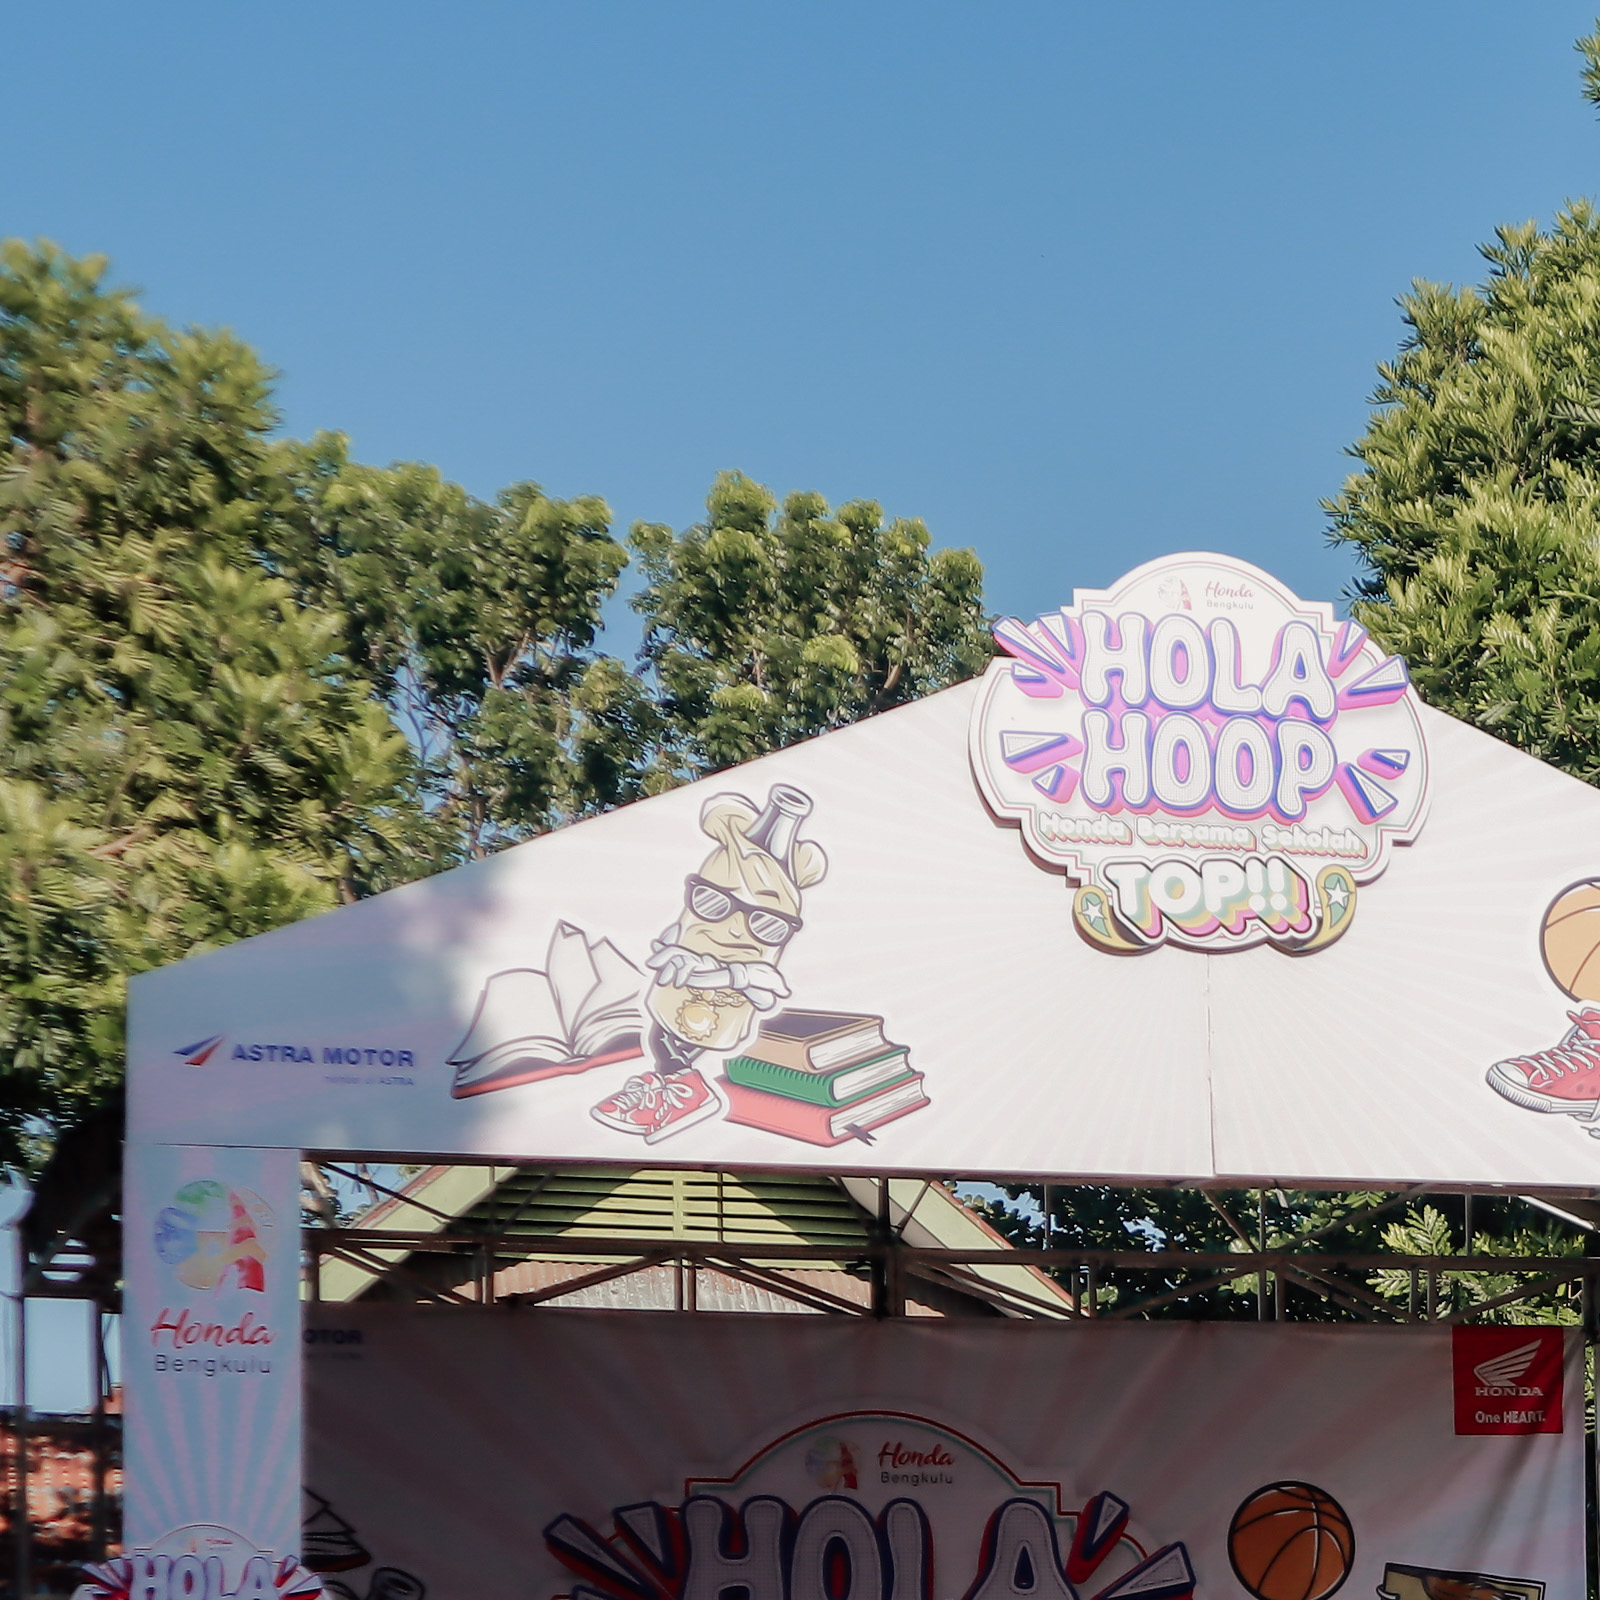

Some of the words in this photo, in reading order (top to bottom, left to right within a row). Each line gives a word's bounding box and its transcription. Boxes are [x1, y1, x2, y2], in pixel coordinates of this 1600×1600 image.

[1205, 580, 1254, 599] Honda
[1206, 600, 1254, 610] Bengkulu
[1081, 612, 1336, 720] HOLA
[1080, 708, 1337, 816] HOOP
[1040, 813, 1131, 844] Honda
[1137, 816, 1255, 848] Bersama
[1261, 824, 1366, 857] Sekolah
[1104, 857, 1306, 932] TOP!!
[231, 1044, 315, 1063] ASTRA
[322, 1047, 414, 1067] MOTOR
[151, 1308, 276, 1348] Honda
[302, 1328, 363, 1344] OTOR
[154, 1354, 271, 1377] Bengkulu
[1474, 1386, 1544, 1397] HONDA
[1475, 1410, 1500, 1423] One
[1503, 1410, 1546, 1424] HEART.
[877, 1441, 955, 1468] Honda
[881, 1471, 953, 1486] Bengkulu
